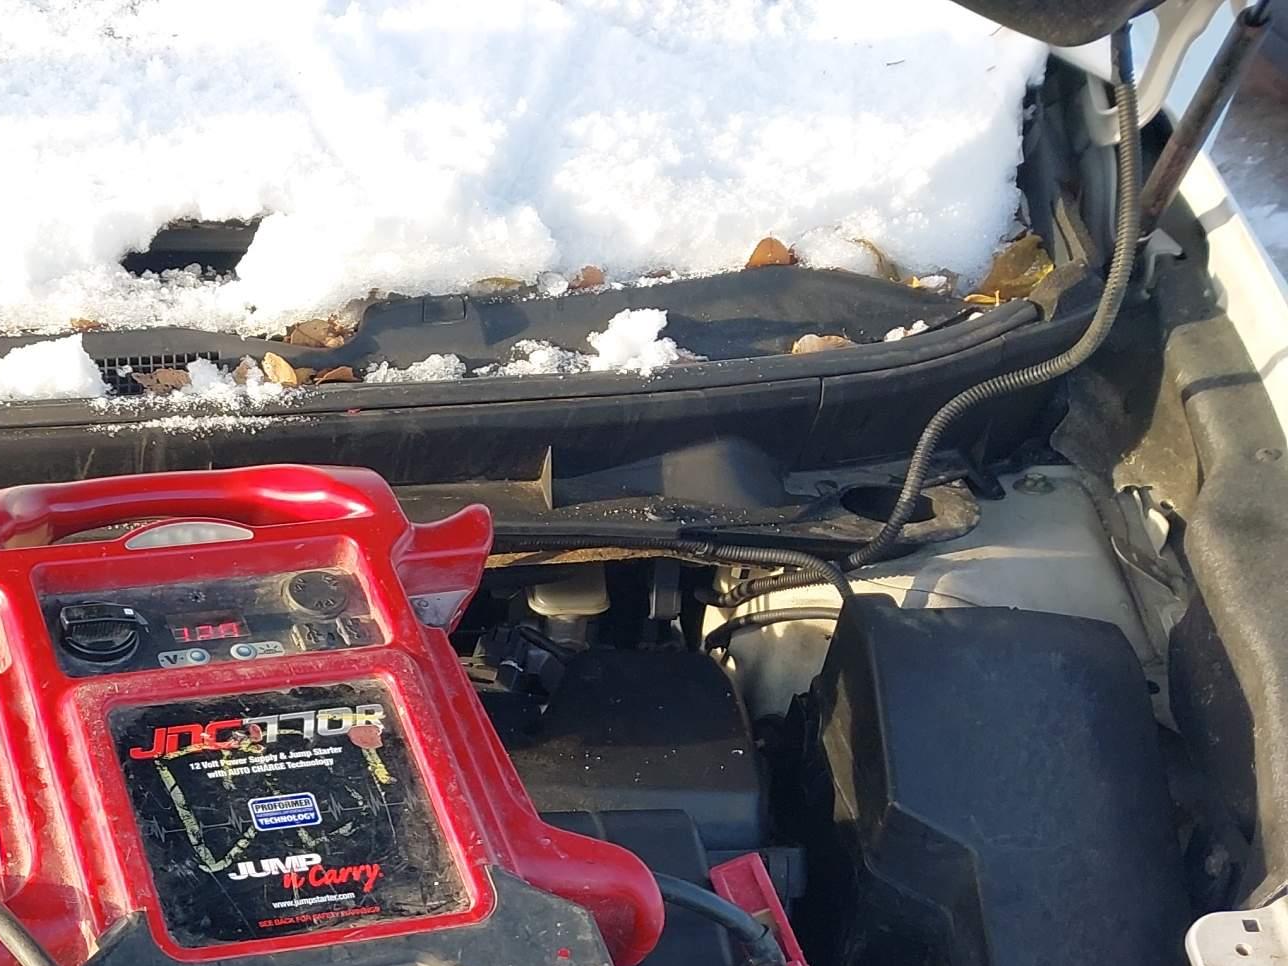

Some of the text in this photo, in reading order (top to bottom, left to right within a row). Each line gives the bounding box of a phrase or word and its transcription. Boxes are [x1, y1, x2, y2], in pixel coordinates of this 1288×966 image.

[189, 746, 343, 771] 12 Volt Power Supply & Jump Starter
[206, 757, 334, 779] with AUTO CHARGE Technology
[254, 799, 311, 812] PROFORMER
[258, 812, 316, 825] TECHNOLOGY
[227, 852, 322, 881] JUMP
[272, 892, 355, 909] www.jumpstarter.com
